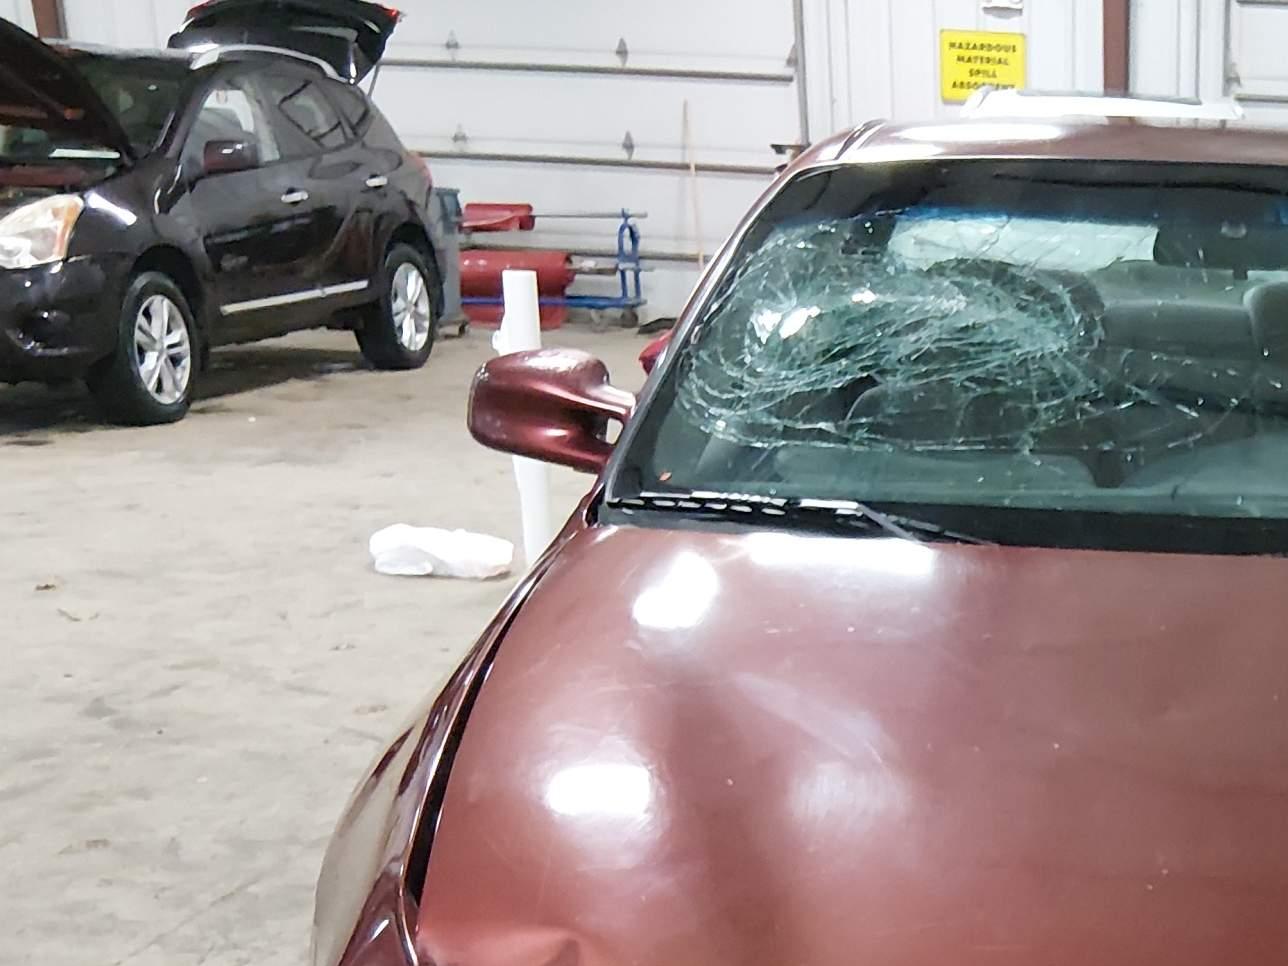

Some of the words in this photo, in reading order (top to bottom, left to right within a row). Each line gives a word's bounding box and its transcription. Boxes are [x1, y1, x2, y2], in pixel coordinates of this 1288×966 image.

[948, 42, 1017, 53] HAZARDOUS
[956, 55, 1009, 66] MATERIAL
[968, 68, 998, 78] SPILL
